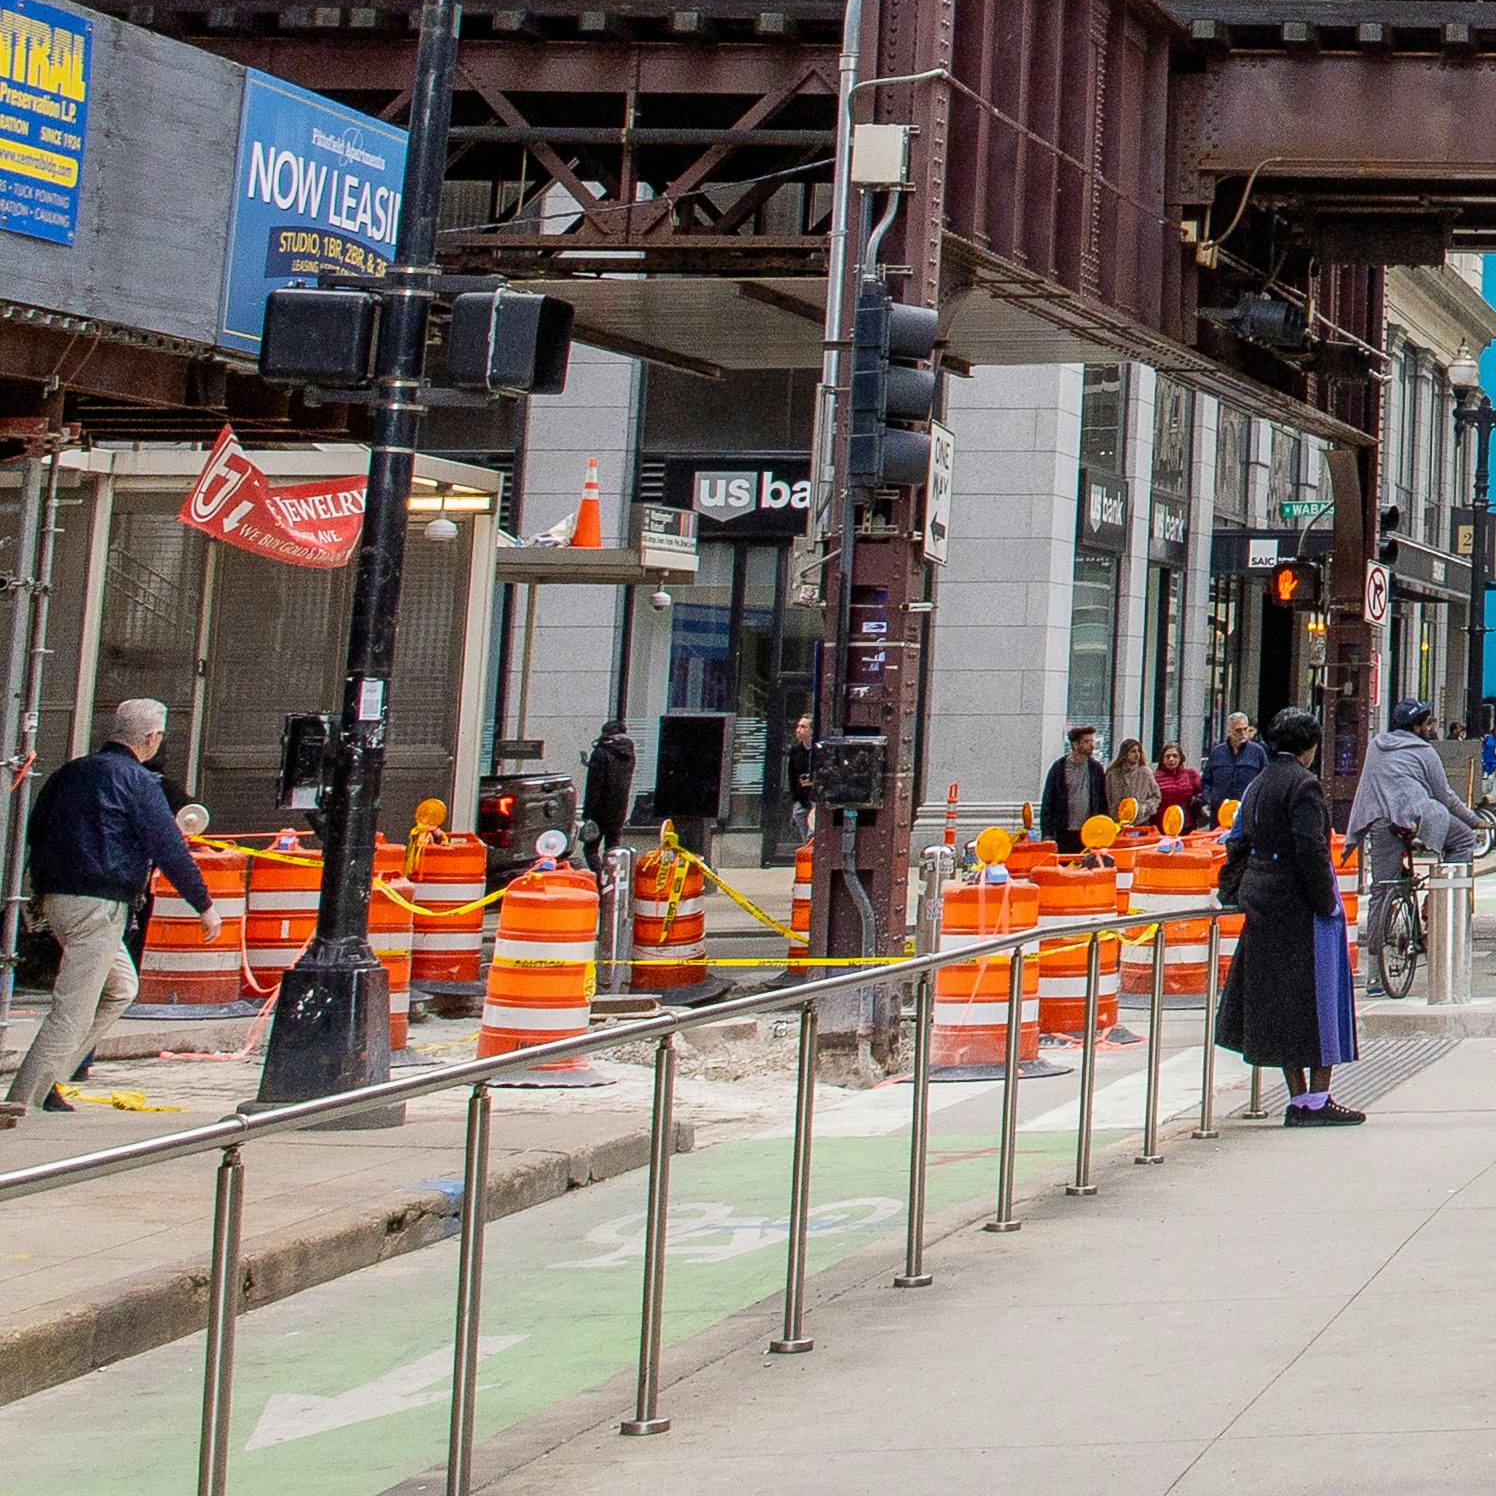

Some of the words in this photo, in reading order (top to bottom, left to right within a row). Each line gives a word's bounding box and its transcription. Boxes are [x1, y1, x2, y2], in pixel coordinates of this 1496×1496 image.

[247, 141, 328, 220] NOW
[278, 231, 321, 258] STUDIO,
[700, 478, 750, 507] us
[760, 471, 811, 508] ba
[1251, 555, 1275, 567] SAIC
